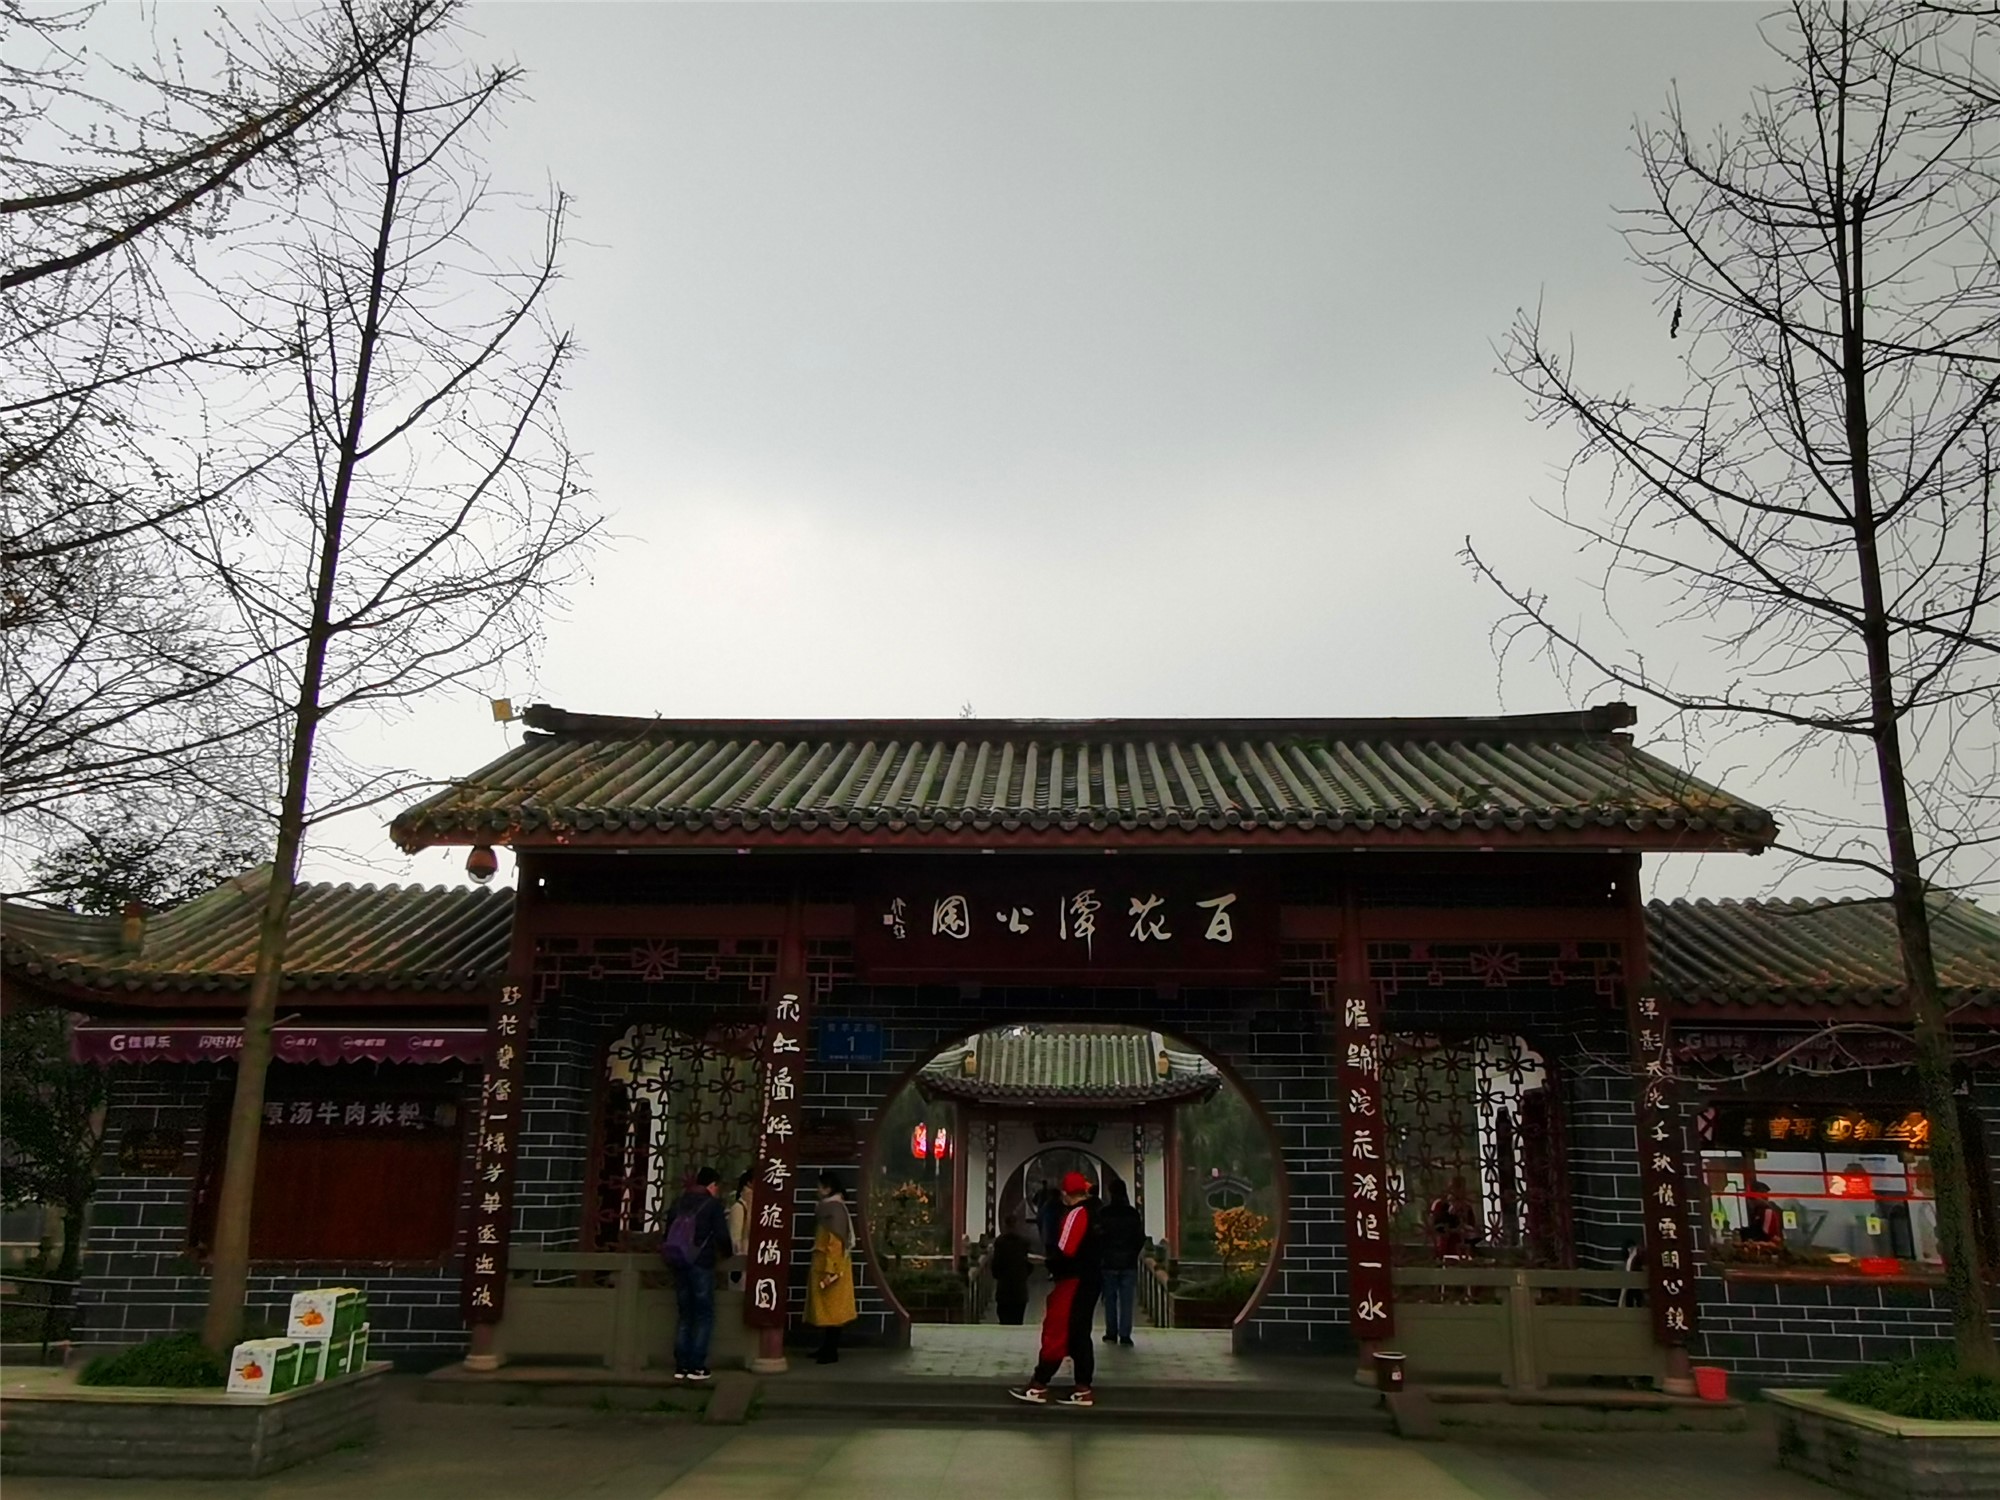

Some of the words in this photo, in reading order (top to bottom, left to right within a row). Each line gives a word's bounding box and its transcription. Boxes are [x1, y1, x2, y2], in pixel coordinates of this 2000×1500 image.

[128, 1035, 171, 1048] 佳得乐
[847, 1035, 855, 1052] 1
